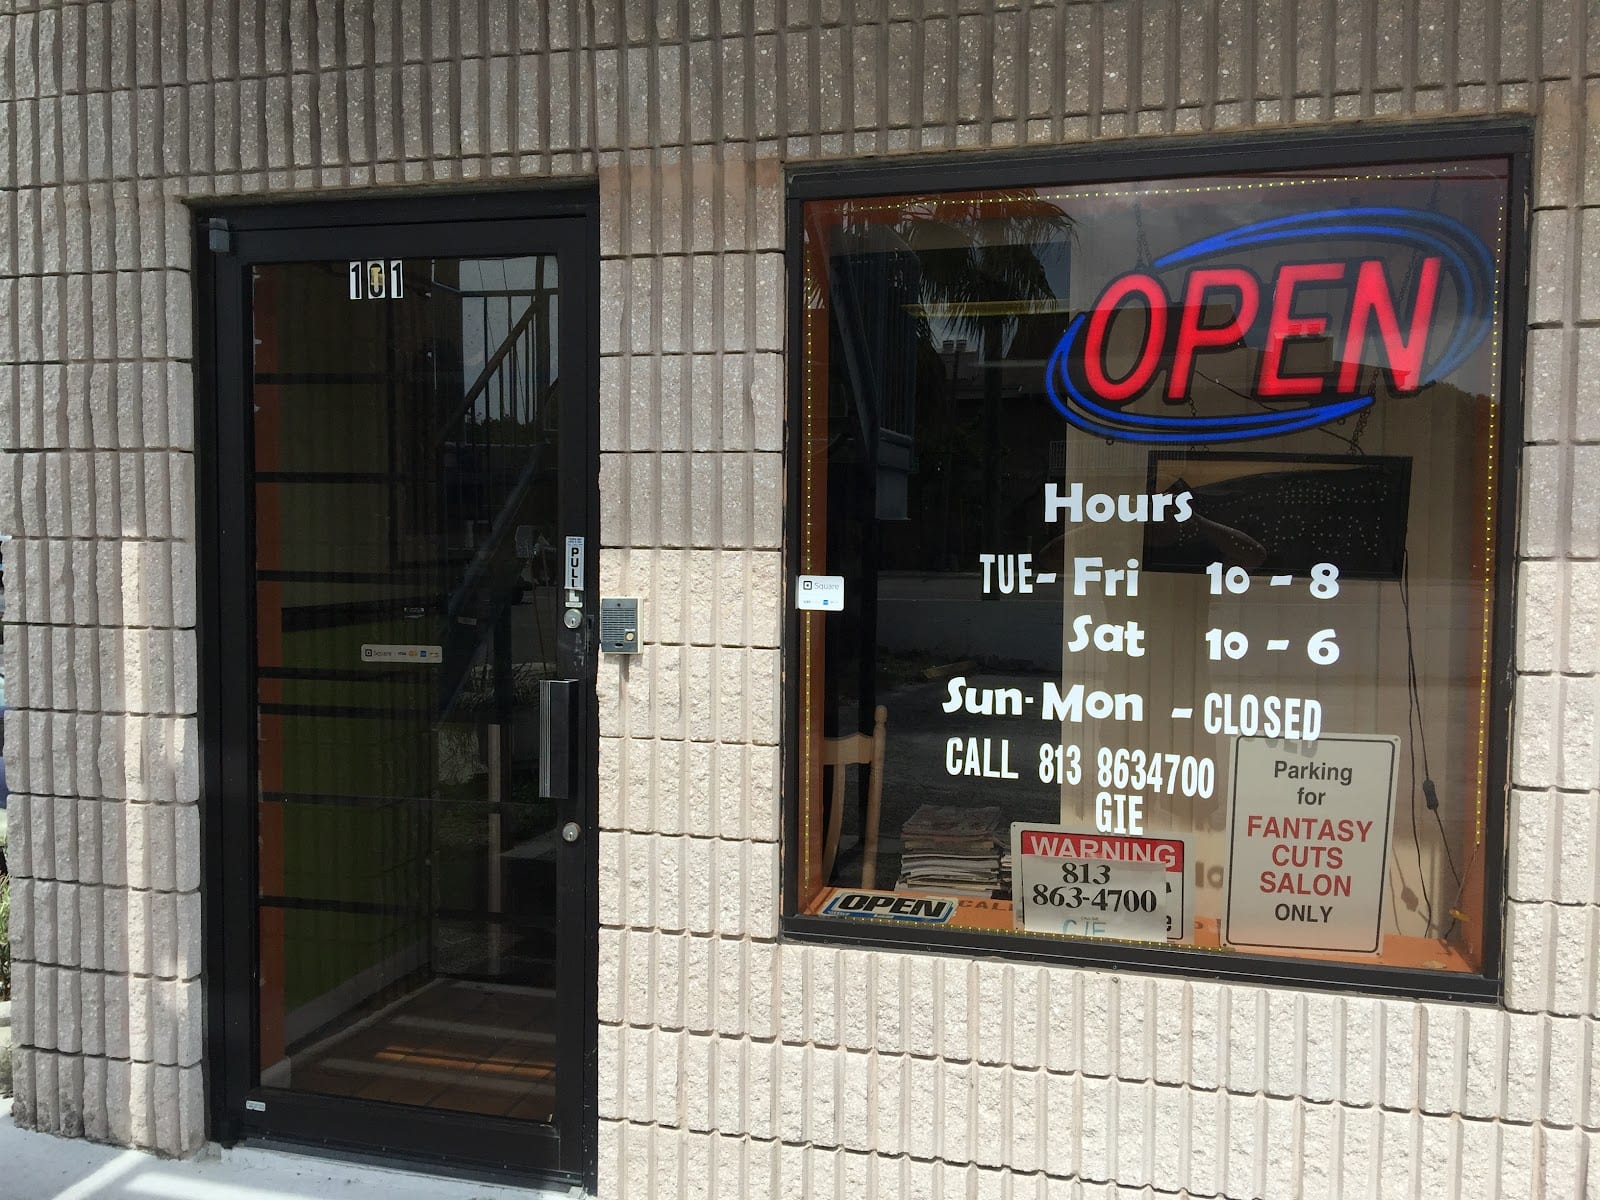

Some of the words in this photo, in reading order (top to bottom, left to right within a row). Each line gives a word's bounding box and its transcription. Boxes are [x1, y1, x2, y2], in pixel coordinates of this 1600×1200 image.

[350, 261, 403, 298] 101
[1083, 256, 1442, 401] OPEN
[1044, 483, 1194, 523] Hours
[570, 547, 580, 588] PULL
[1073, 557, 1139, 597] Fri
[1205, 562, 1250, 595] 10
[1309, 563, 1340, 599] 8
[814, 582, 840, 591] Square
[1067, 614, 1145, 657] Sat
[1205, 628, 1249, 661] 10
[1307, 628, 1340, 665] 6
[1204, 692, 1322, 741] CLOSED
[946, 737, 1019, 779] CALL
[1039, 743, 1082, 786] 813
[1097, 746, 1215, 799] 8634700
[1274, 760, 1353, 786] Parking
[1297, 787, 1326, 806] for
[1095, 791, 1144, 836] GIE
[1247, 815, 1373, 843] FANTASY
[1030, 835, 1177, 869] WARNING
[1272, 844, 1344, 870] CUTS
[1061, 862, 1112, 885] 813
[1259, 871, 1352, 897] SALON
[838, 894, 948, 918] OPEN
[1032, 883, 1158, 913] 863-4700
[1274, 903, 1334, 923] ONLY
